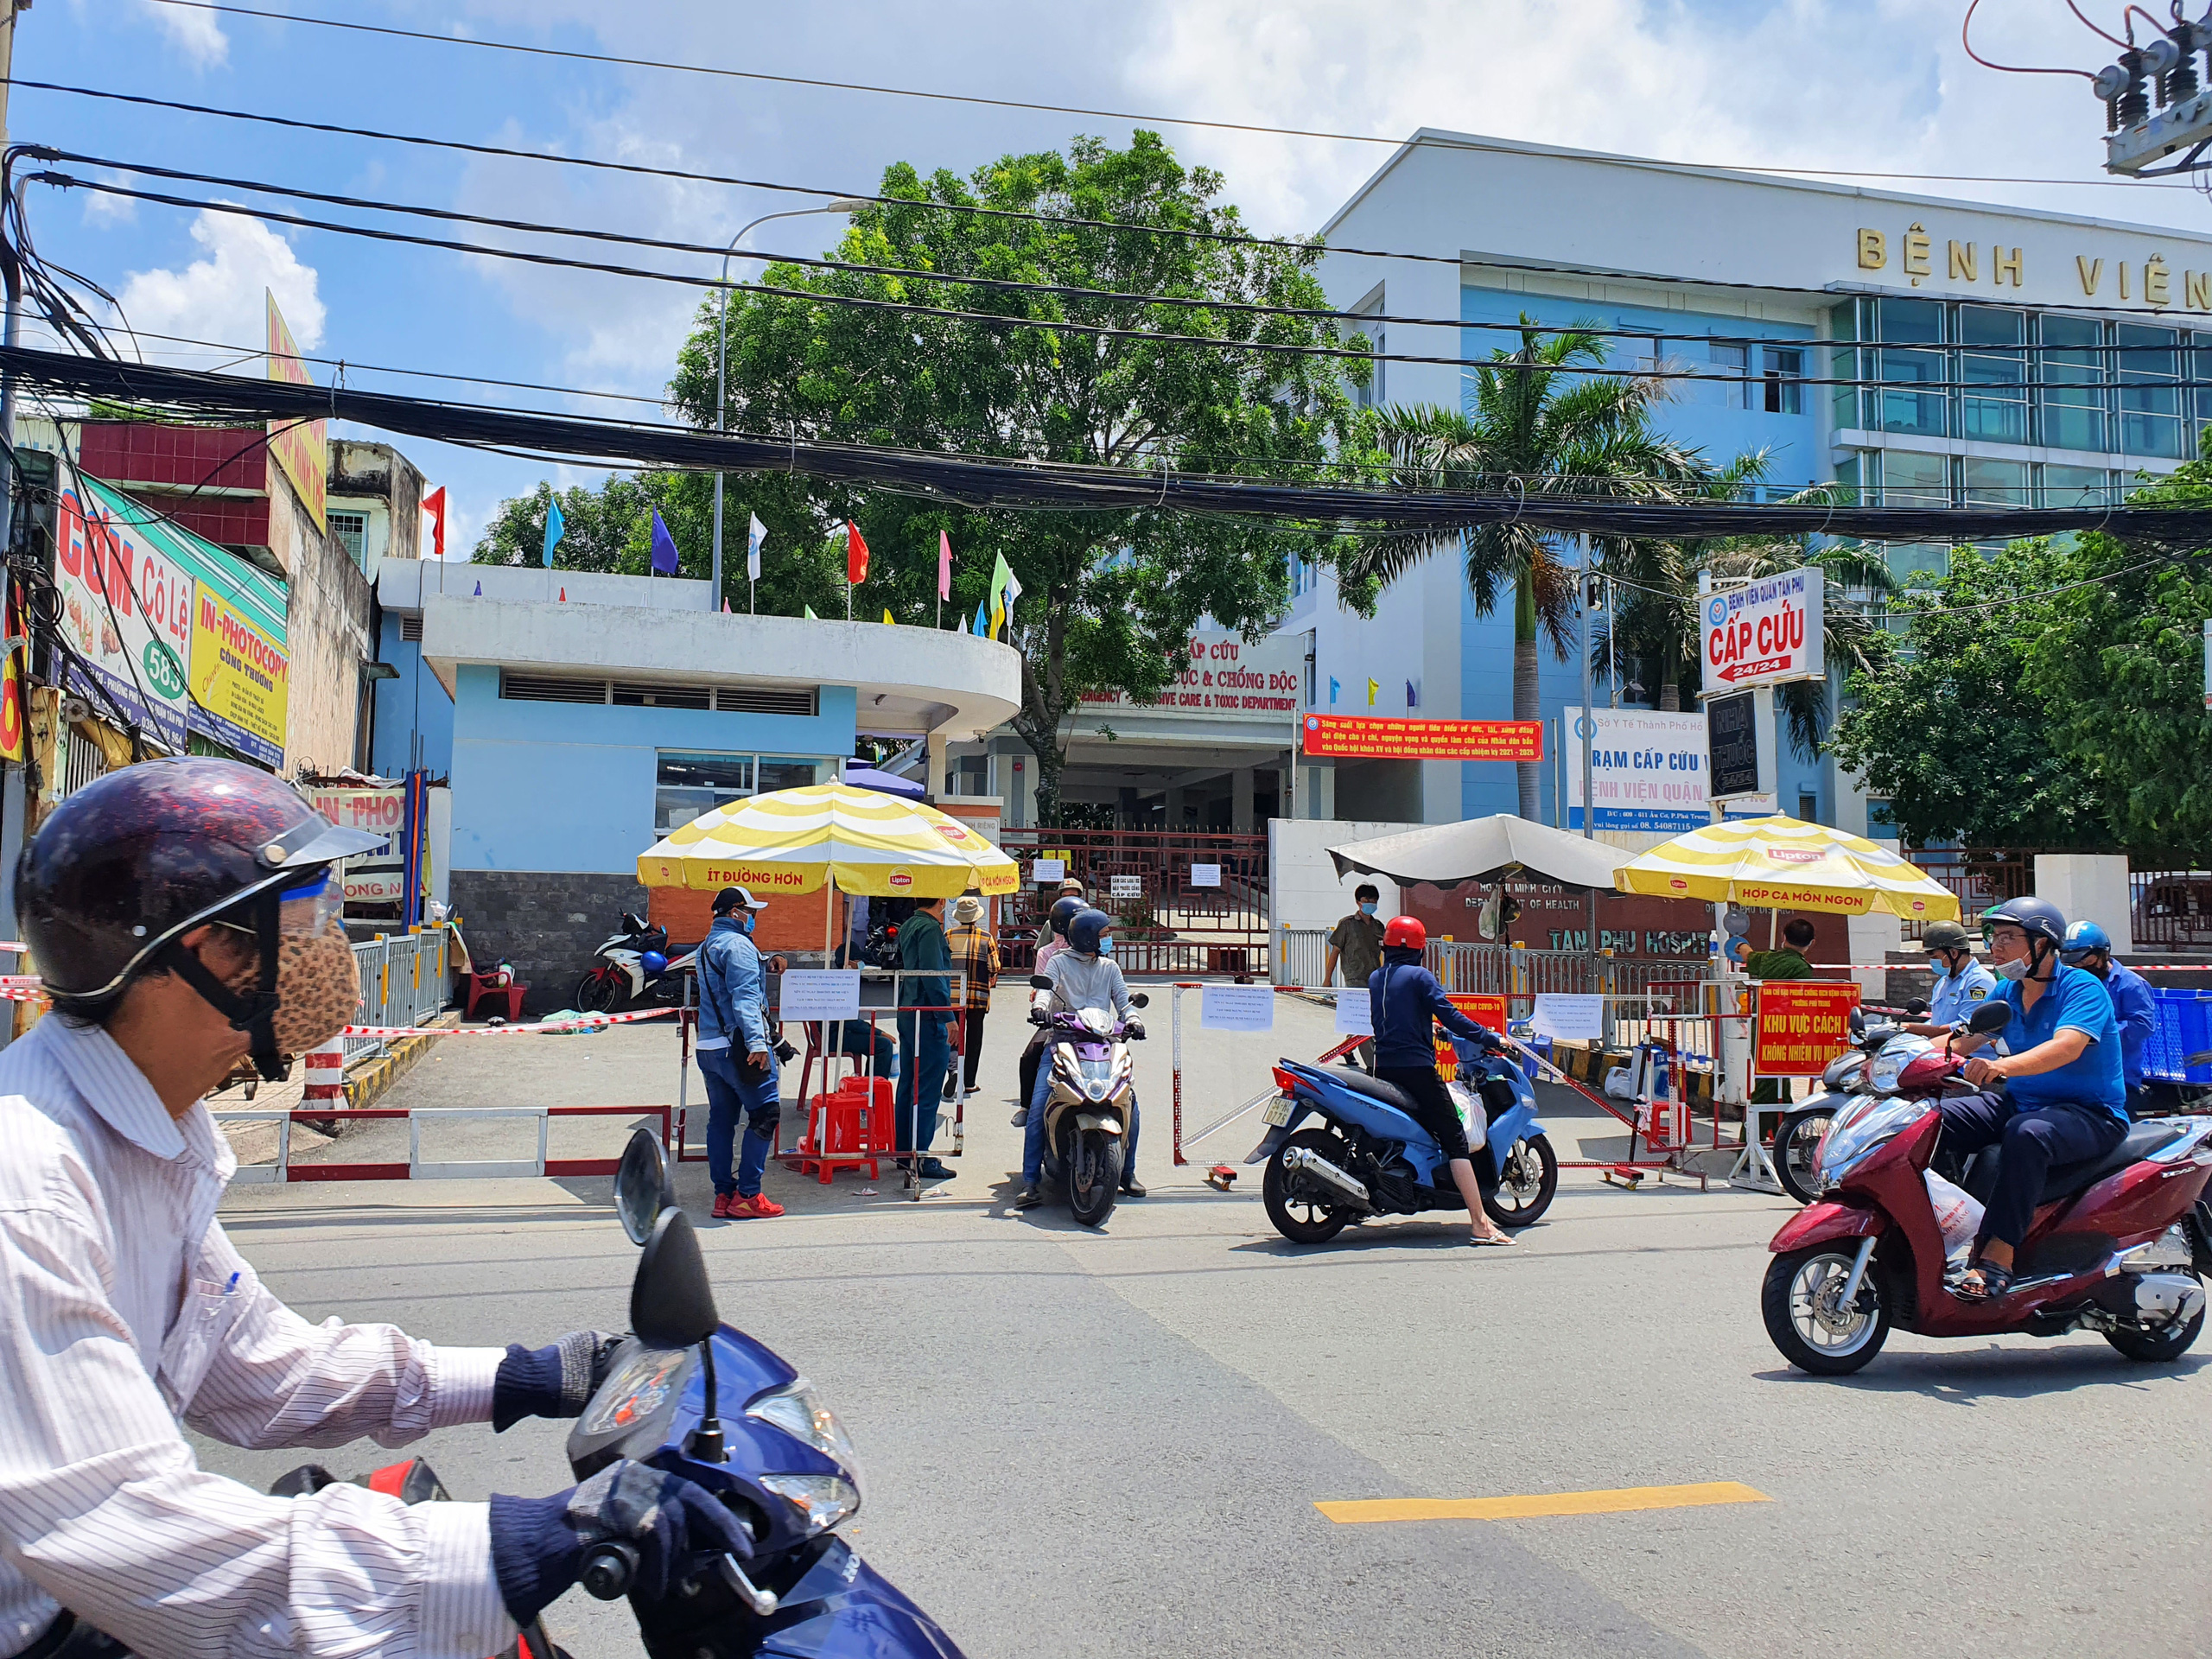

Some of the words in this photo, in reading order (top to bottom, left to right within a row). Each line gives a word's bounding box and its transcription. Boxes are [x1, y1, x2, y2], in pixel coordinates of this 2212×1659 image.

[1857, 221, 2022, 287] BỆNH
[1729, 590, 1745, 613] BỆNH
[1745, 585, 1759, 608] VIỆN
[1760, 580, 1777, 604] QUẬN
[1778, 576, 1790, 598] TÂN
[200, 592, 289, 683] IN-PHOTOCOPY
[1709, 612, 1752, 665] CẤP
[1758, 600, 1803, 655] CỨU
[1188, 636, 1205, 659] ẤP
[1211, 639, 1239, 661] CỨU
[149, 646, 181, 692] 583
[219, 647, 242, 672] CÔNG
[245, 663, 273, 693] THƯƠNG
[1203, 673, 1213, 687] &
[1217, 665, 1264, 690] CHỐNG
[1269, 671, 1297, 694] ĐỘC
[1733, 658, 1781, 677] 24/24
[1179, 693, 1201, 707] CARE
[1205, 696, 1211, 707] &
[1214, 695, 1239, 709] TOXIC
[1243, 696, 1297, 710] DEPARTMENT
[1321, 720, 1337, 729] Sáng
[1598, 717, 1610, 728] Sở
[1613, 719, 1619, 728] Y
[1623, 717, 1634, 728] Tế
[1637, 720, 1666, 730] Thành
[1669, 719, 1688, 731] Phố
[1690, 719, 1703, 731] Hồ
[1715, 698, 1749, 734] NHÀ
[1333, 743, 1348, 752] Quốc
[1592, 750, 1628, 771] RẠM
[1633, 747, 1663, 771] CẤP
[1669, 750, 1698, 772] CỨU
[1713, 731, 1754, 769] THUỐC
[1624, 779, 1657, 803] VIỆN
[1662, 782, 1702, 801] QUẬN
[977, 821, 995, 830] RIÊNG
[1772, 850, 1821, 862] Lipton
[707, 867, 721, 881] ÍT
[722, 867, 771, 884] ĐƯỜNG
[774, 871, 803, 886] HƠN
[891, 875, 910, 886] Lipton
[1514, 883, 1536, 893] MINH
[1542, 884, 1563, 894] CITY
[1529, 899, 1543, 909] OF
[1554, 899, 1580, 910] HEALTH
[1742, 887, 1769, 902] HỢP
[1792, 889, 1821, 903] MÓN
[1824, 893, 1864, 907] NGON
[1549, 929, 1587, 951] TAN
[1601, 930, 1637, 953] PHU
[1764, 1014, 1787, 1033] KHU
[1789, 1013, 1810, 1037] VỰC
[1813, 1012, 1841, 1033] CÁCH
[1762, 1041, 1787, 1061] KHÔNG
[1789, 1041, 1812, 1065] NHIỆM
[1814, 1046, 1822, 1065] VỤ
